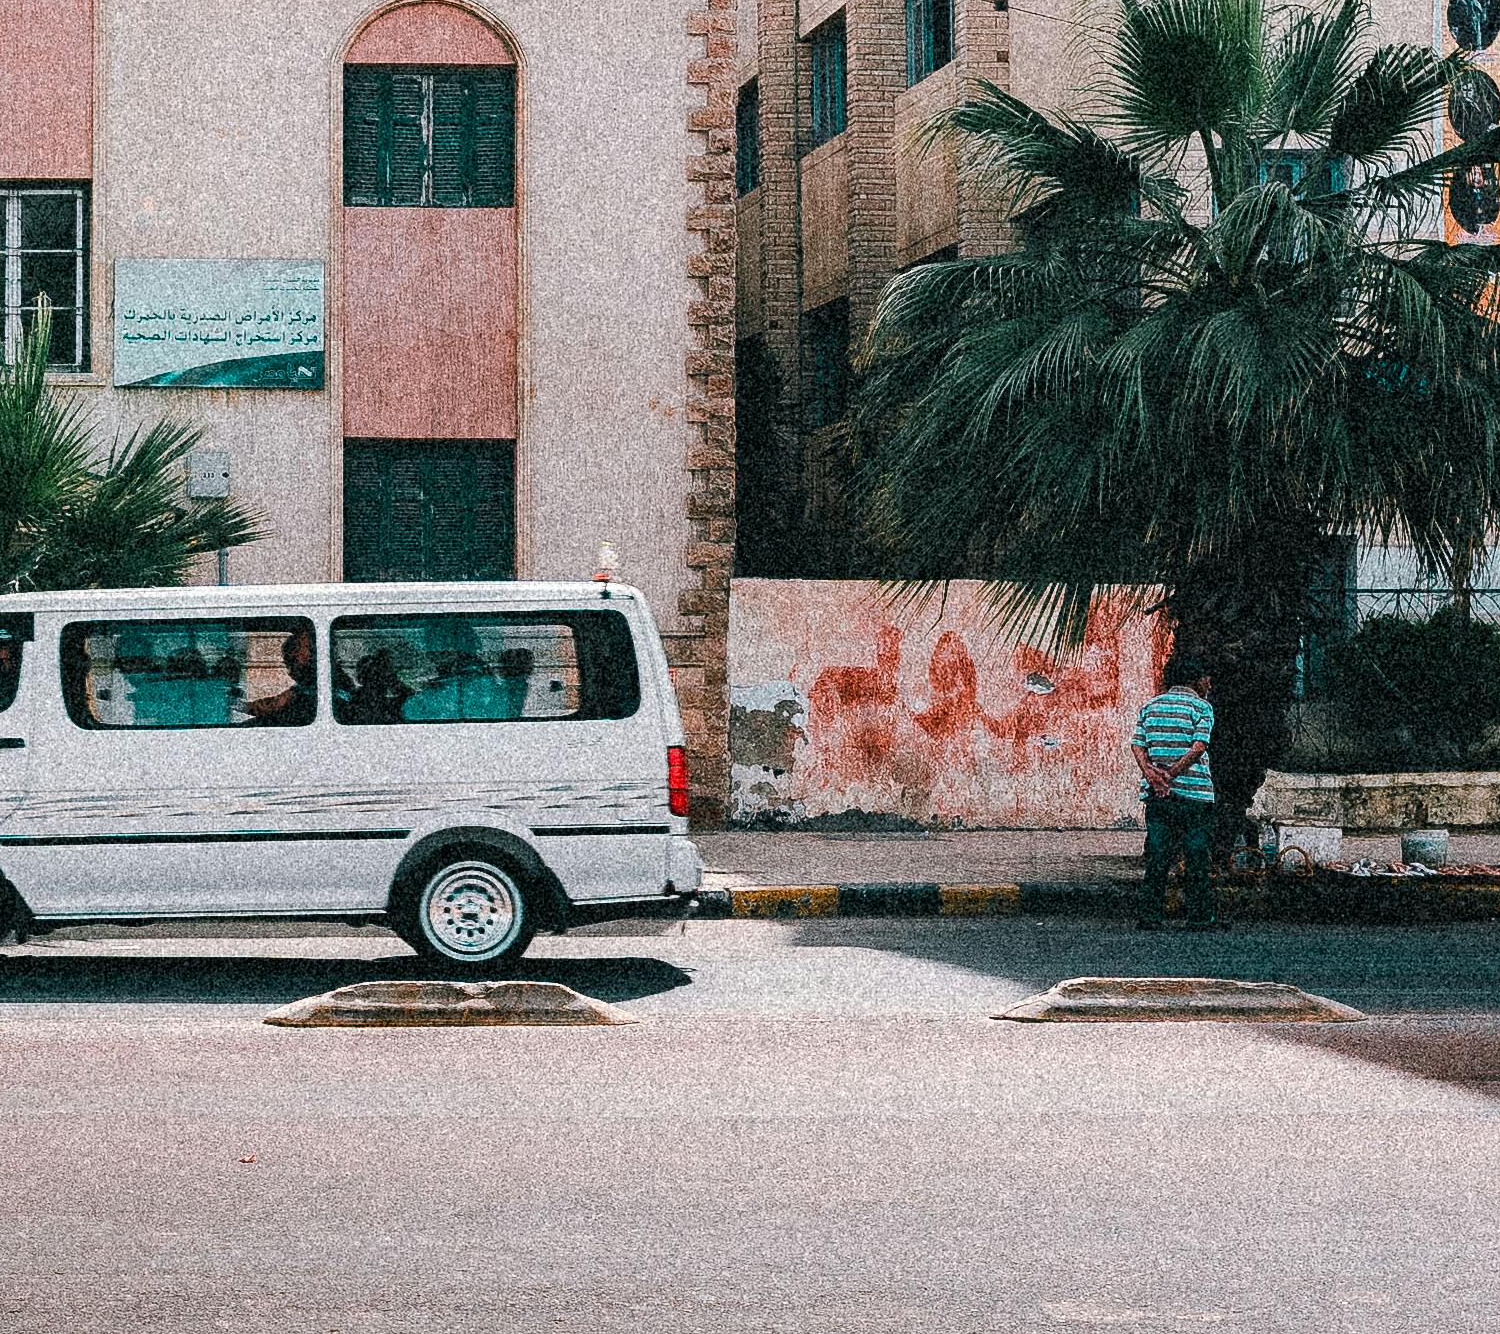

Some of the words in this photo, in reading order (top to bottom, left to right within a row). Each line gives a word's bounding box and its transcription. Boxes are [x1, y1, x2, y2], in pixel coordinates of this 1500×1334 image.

[180, 307, 232, 326] الصدرية
[234, 304, 285, 326] الأمراض
[287, 308, 317, 325] مركز
[174, 328, 232, 345] الشهادات
[234, 329, 286, 347] استخراج
[288, 329, 319, 346] مركز
